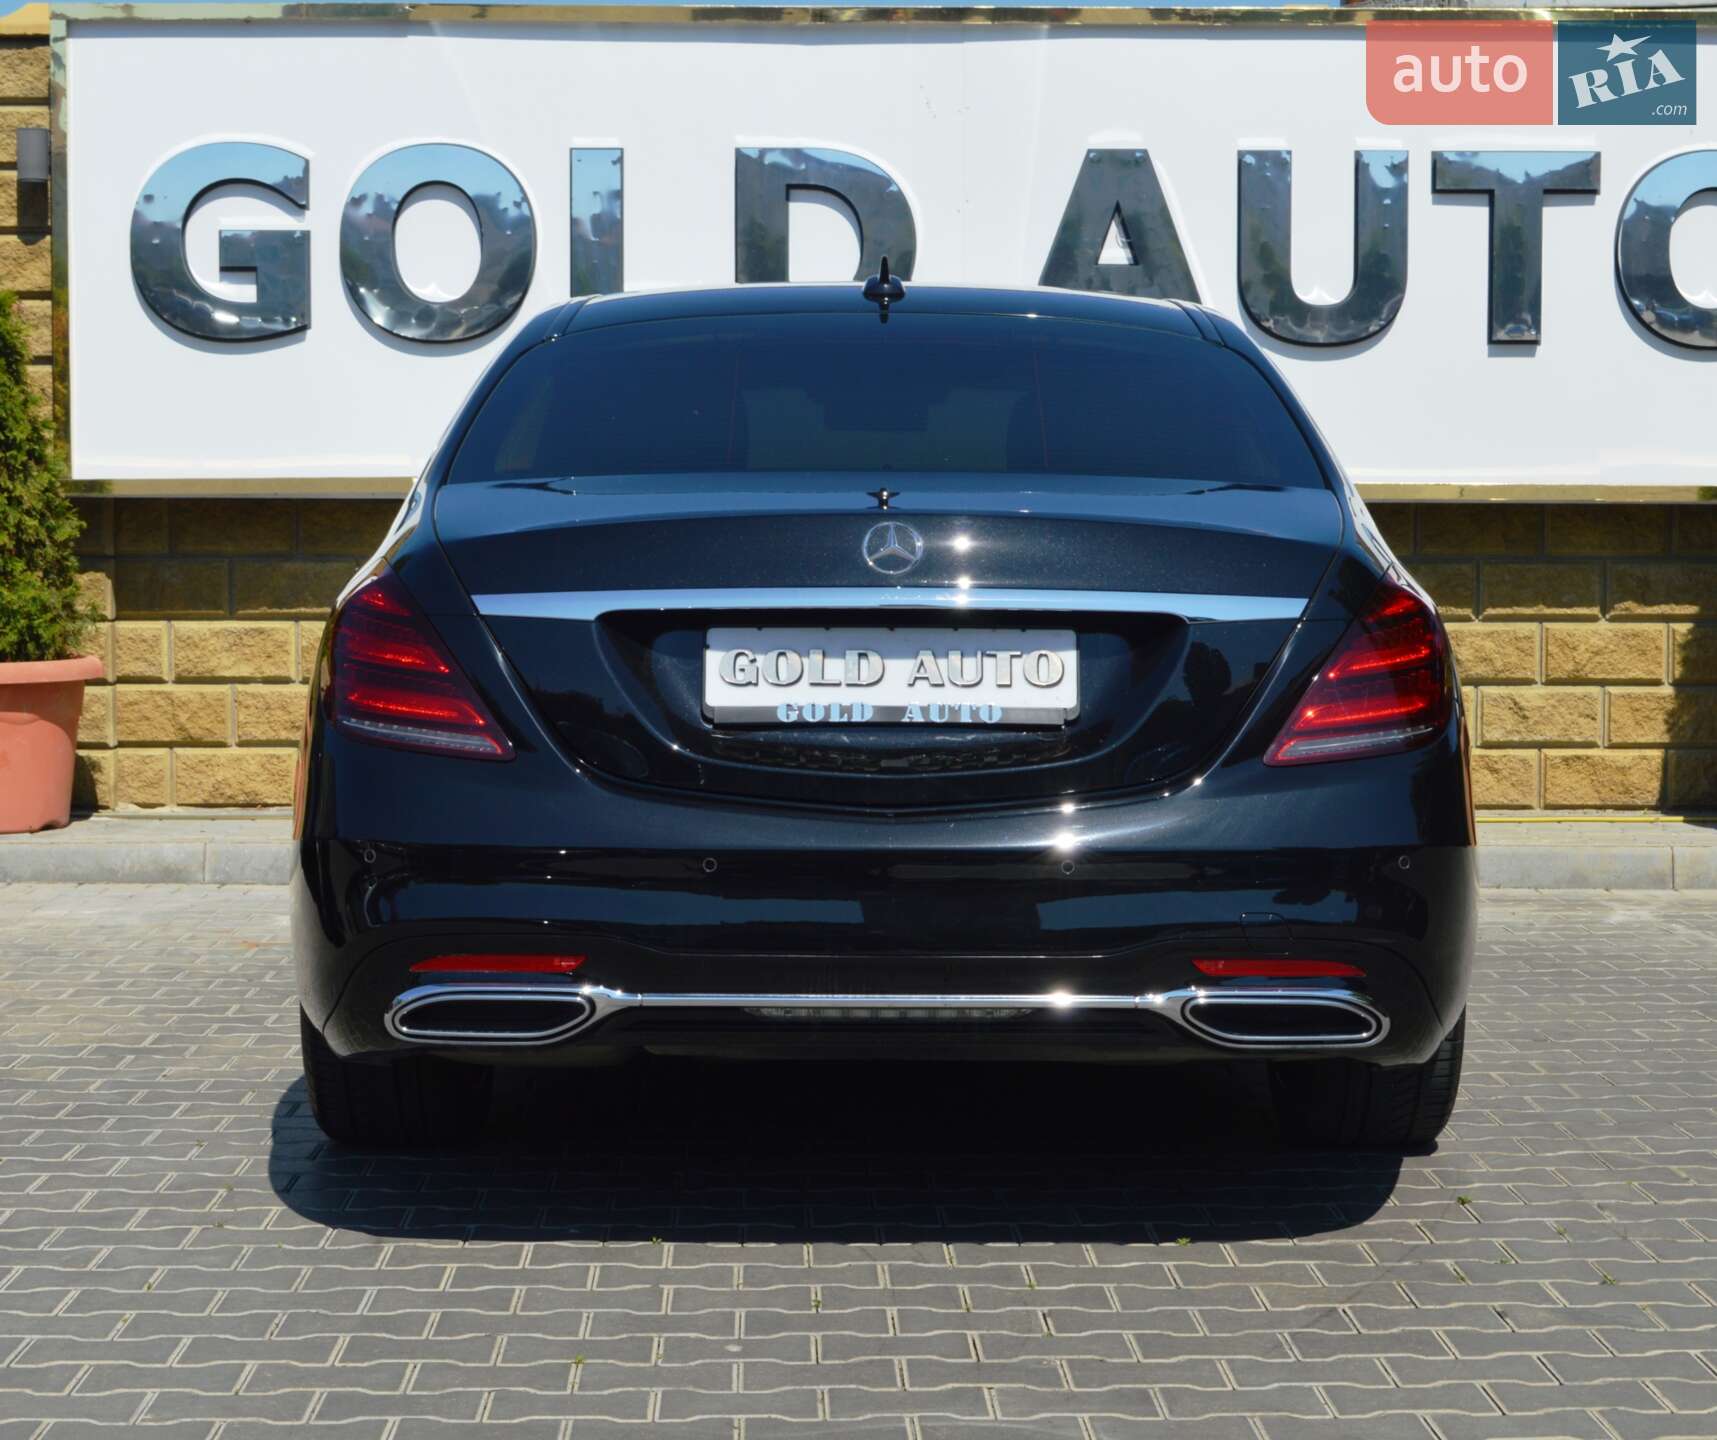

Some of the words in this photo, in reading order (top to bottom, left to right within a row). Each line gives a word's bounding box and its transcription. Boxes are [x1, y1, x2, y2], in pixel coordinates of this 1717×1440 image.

[130, 141, 916, 343] GOLD
[719, 649, 885, 687] GOLD
[907, 649, 1064, 687] AUTO
[776, 702, 874, 723] GOLD
[902, 703, 1003, 724] AUTO
